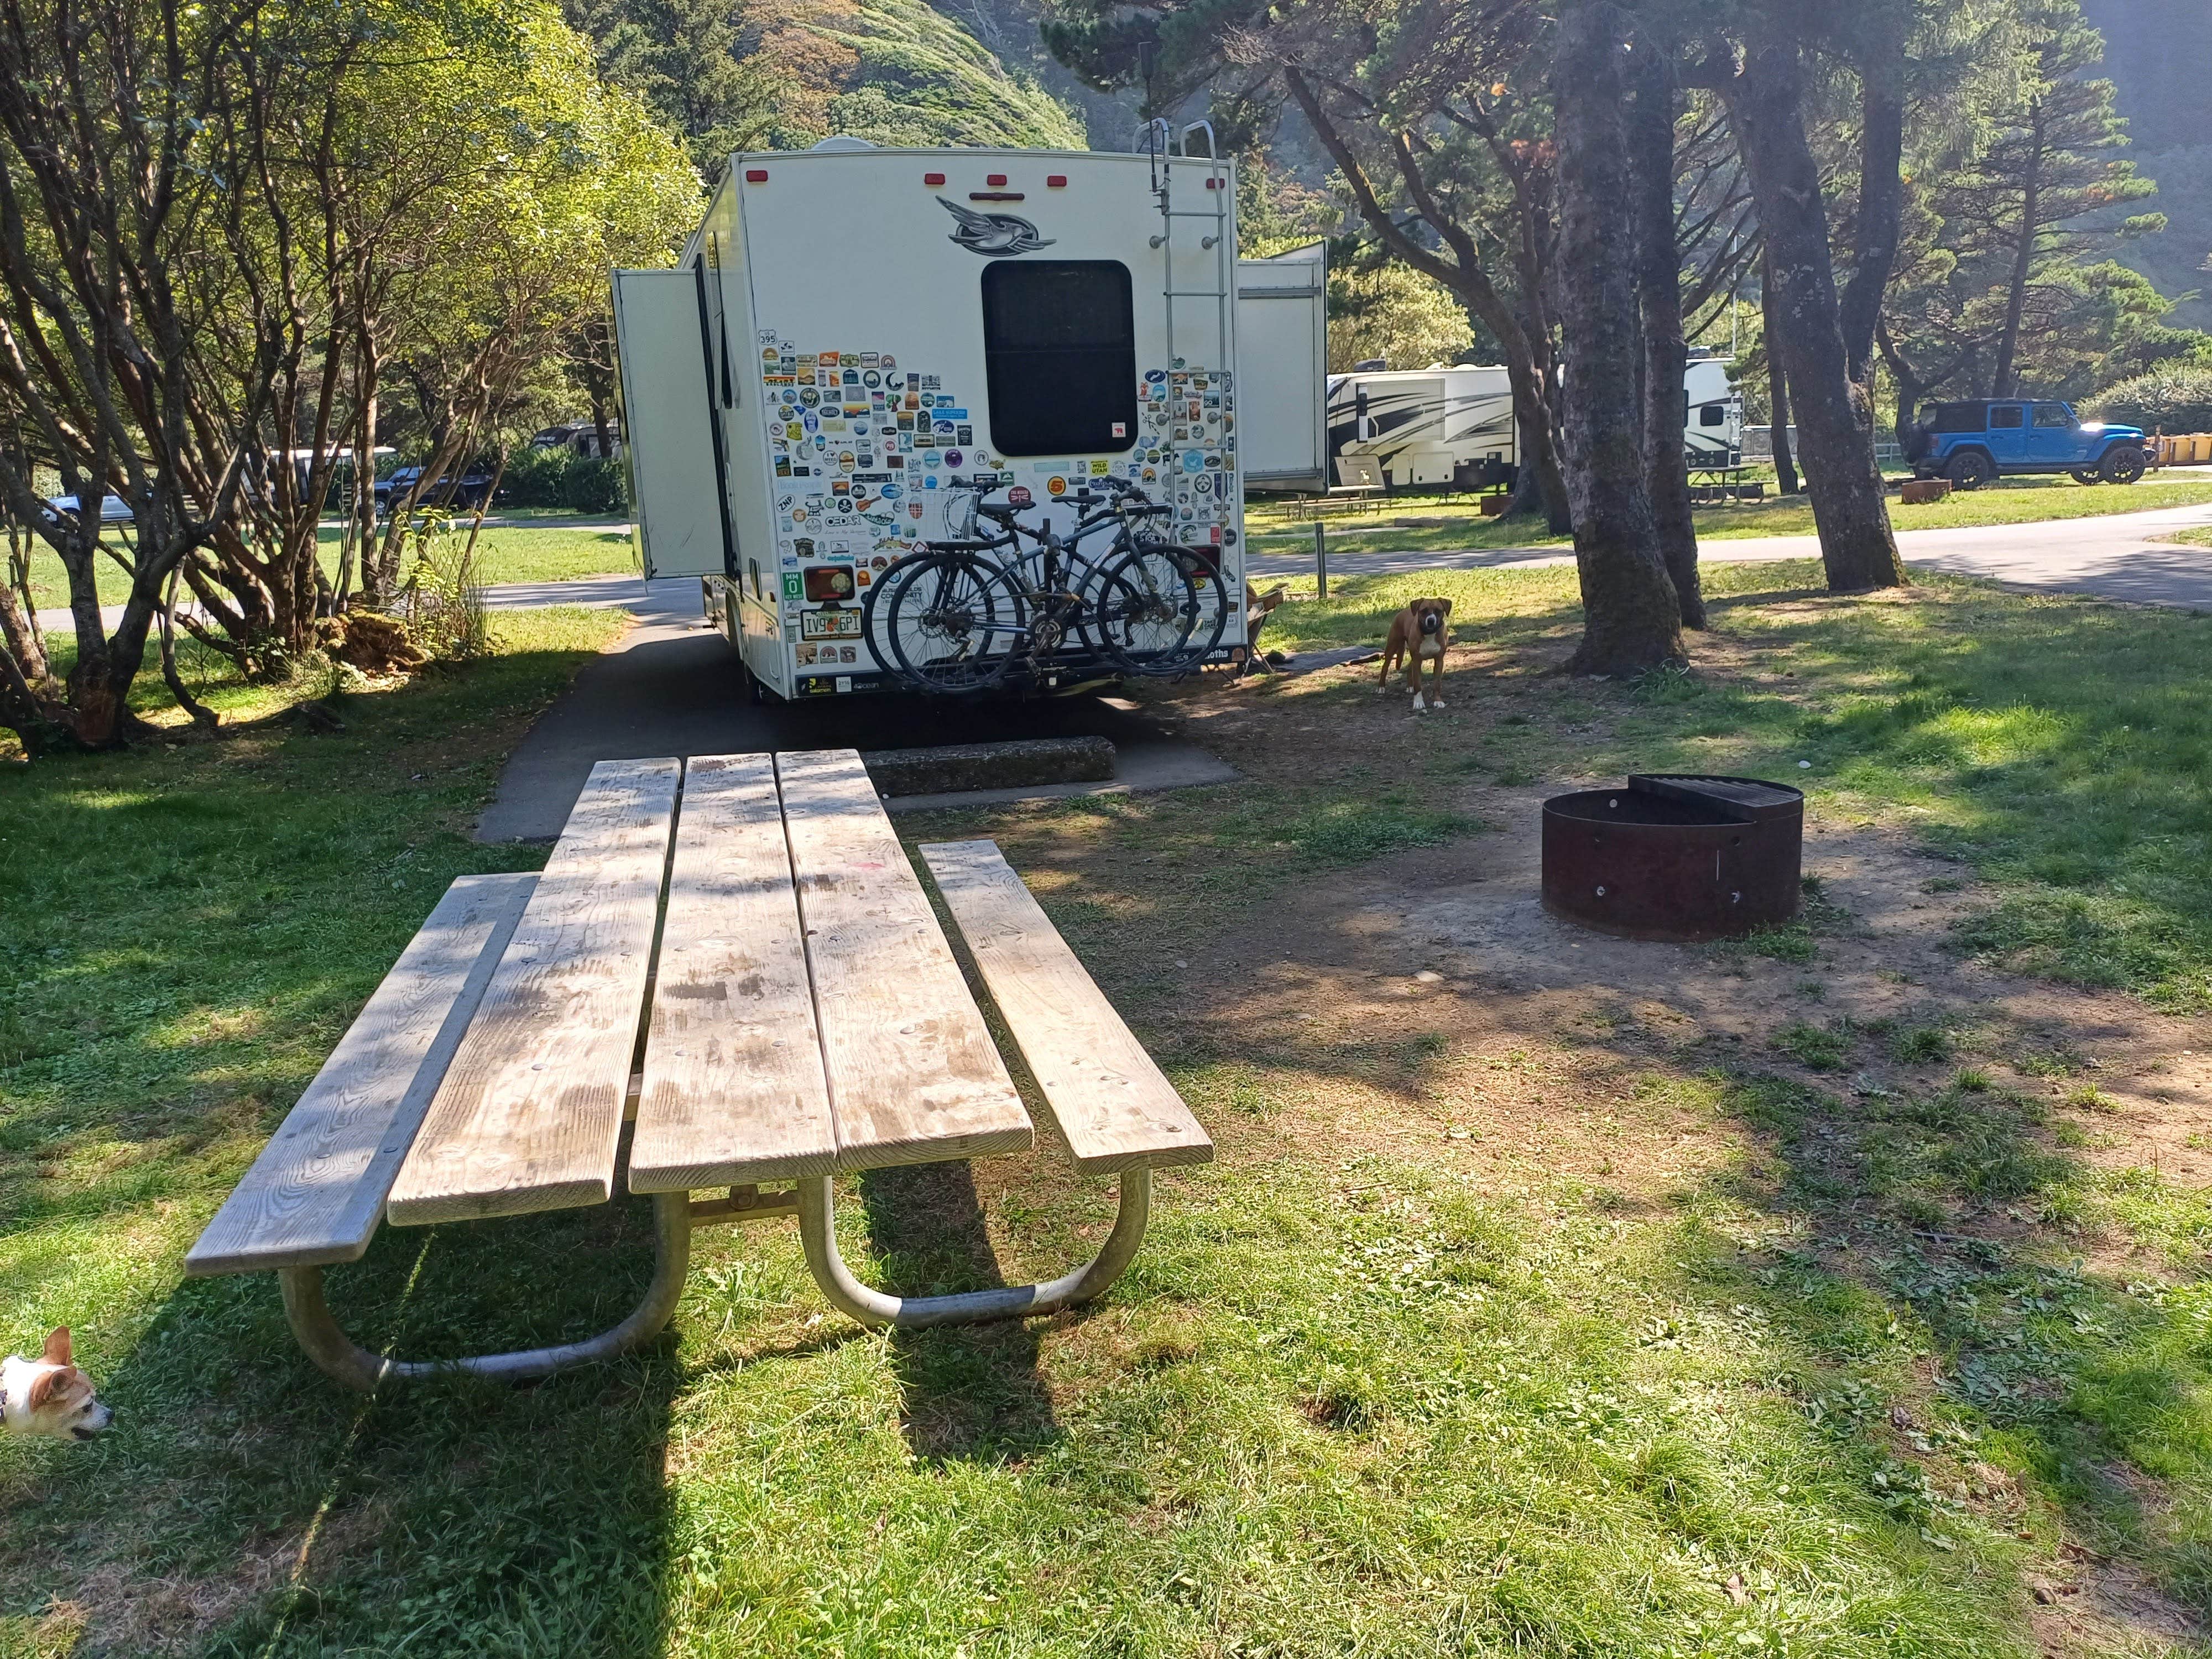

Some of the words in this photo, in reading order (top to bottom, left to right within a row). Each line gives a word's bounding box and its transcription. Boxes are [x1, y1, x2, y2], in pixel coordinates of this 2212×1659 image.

[1051, 481, 1063, 492] 5
[778, 497, 792, 510] ZNP
[826, 515, 861, 526] CEDAR
